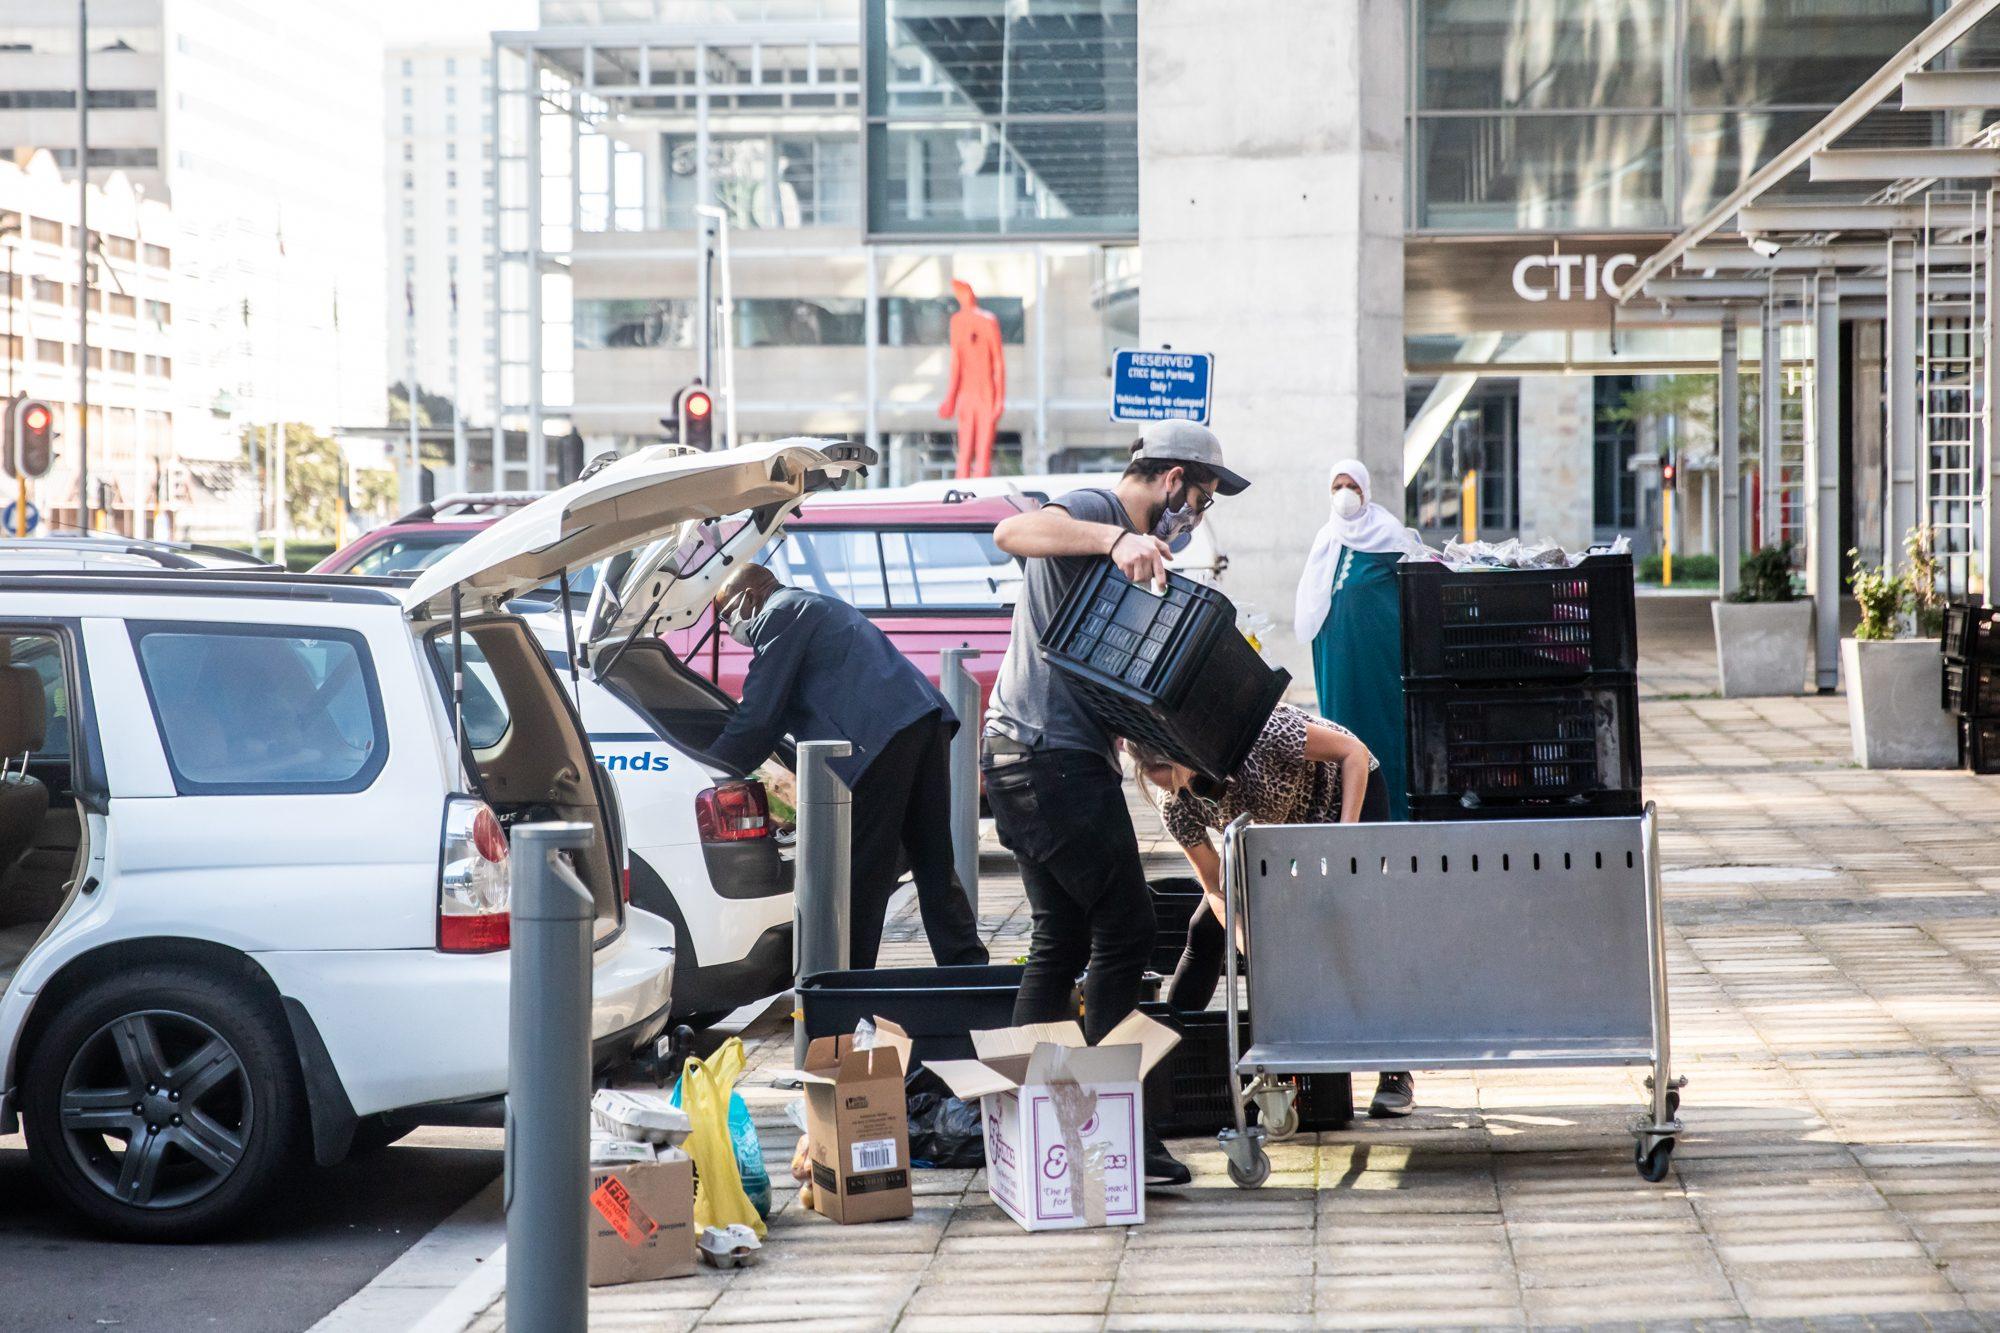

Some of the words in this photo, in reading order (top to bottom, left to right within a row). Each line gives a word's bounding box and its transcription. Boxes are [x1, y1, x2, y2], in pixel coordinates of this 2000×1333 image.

[1512, 254, 1658, 302] CTIC
[1131, 353, 1193, 368] RESERVED
[1150, 368, 1165, 379] Bus
[1166, 369, 1195, 383] Parking
[1150, 381, 1167, 393] Only
[1116, 394, 1146, 405] Vehicles
[1147, 395, 1161, 406] will
[1162, 396, 1172, 406] be
[1173, 397, 1205, 408] clamped
[1053, 1197, 1067, 1208] for
